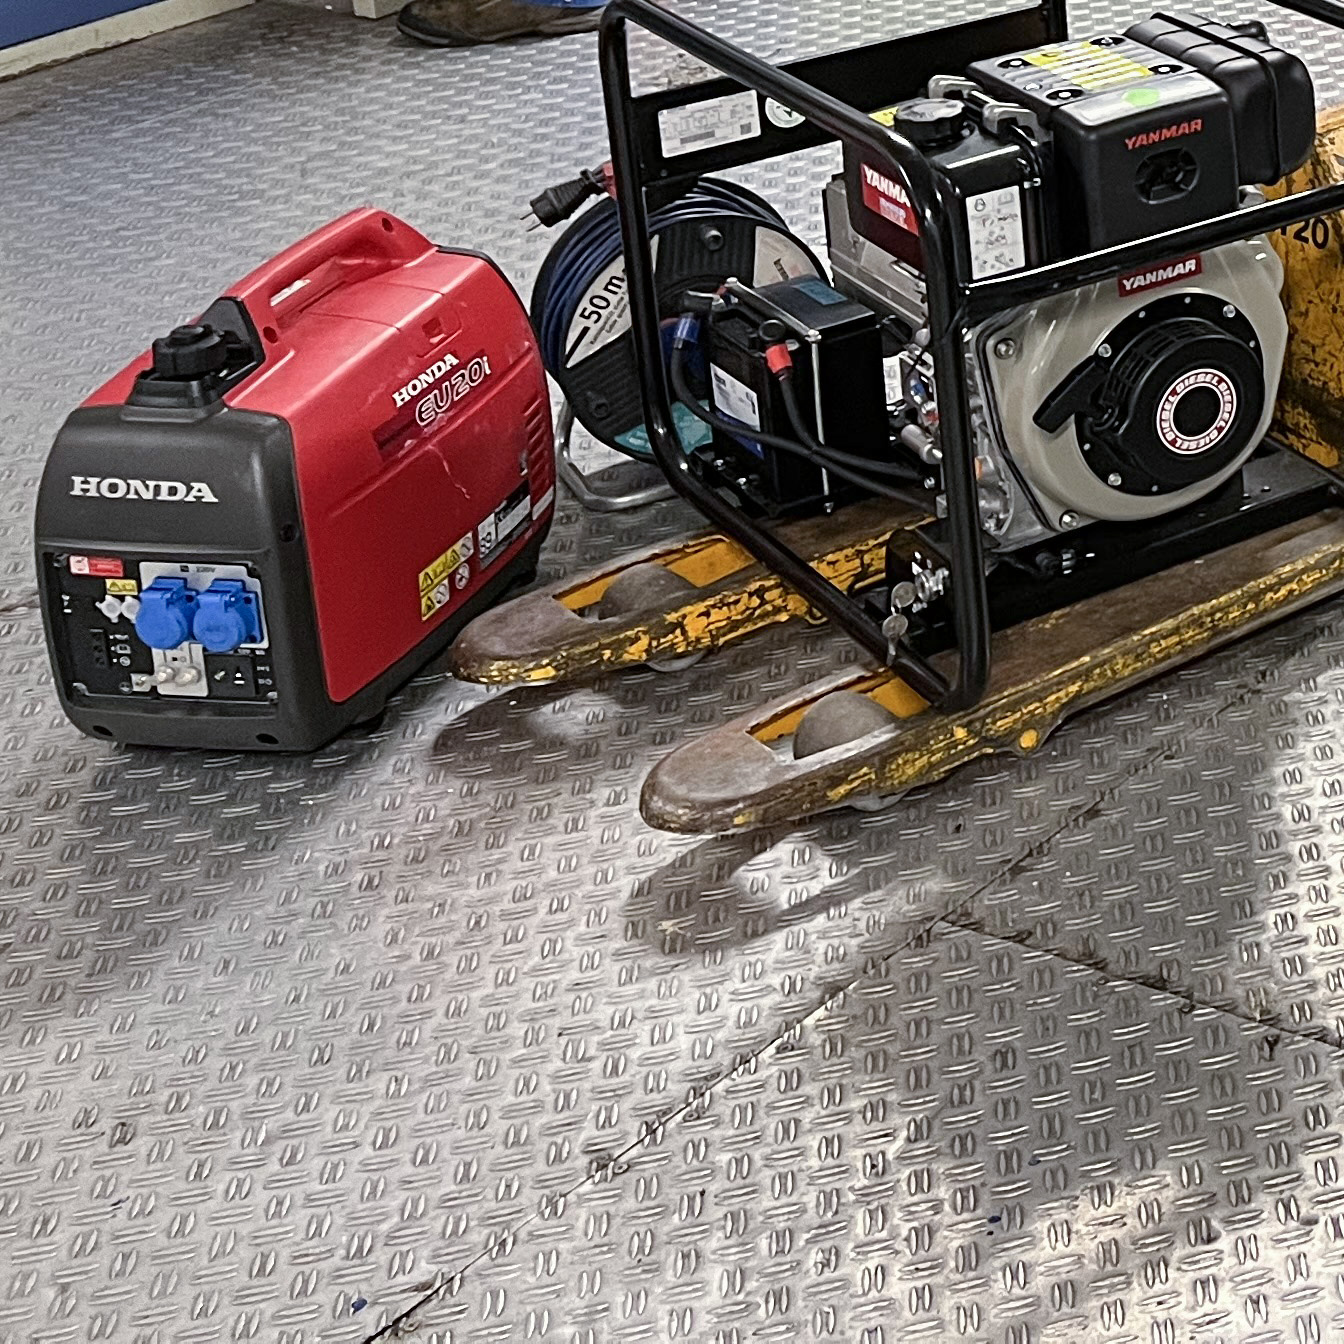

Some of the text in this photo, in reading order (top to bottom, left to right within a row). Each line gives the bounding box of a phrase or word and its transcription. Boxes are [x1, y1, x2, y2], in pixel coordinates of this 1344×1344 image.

[1125, 119, 1203, 151] YANMAR
[862, 165, 912, 209] YANMA
[1122, 259, 1197, 291] YANMAR
[579, 294, 611, 325] 50
[391, 353, 461, 408] HONDA
[415, 355, 492, 427] EU20i
[1160, 372, 1233, 450] DIESEL DIESEL DIESEL DIESEL
[69, 476, 220, 503] HONDA
